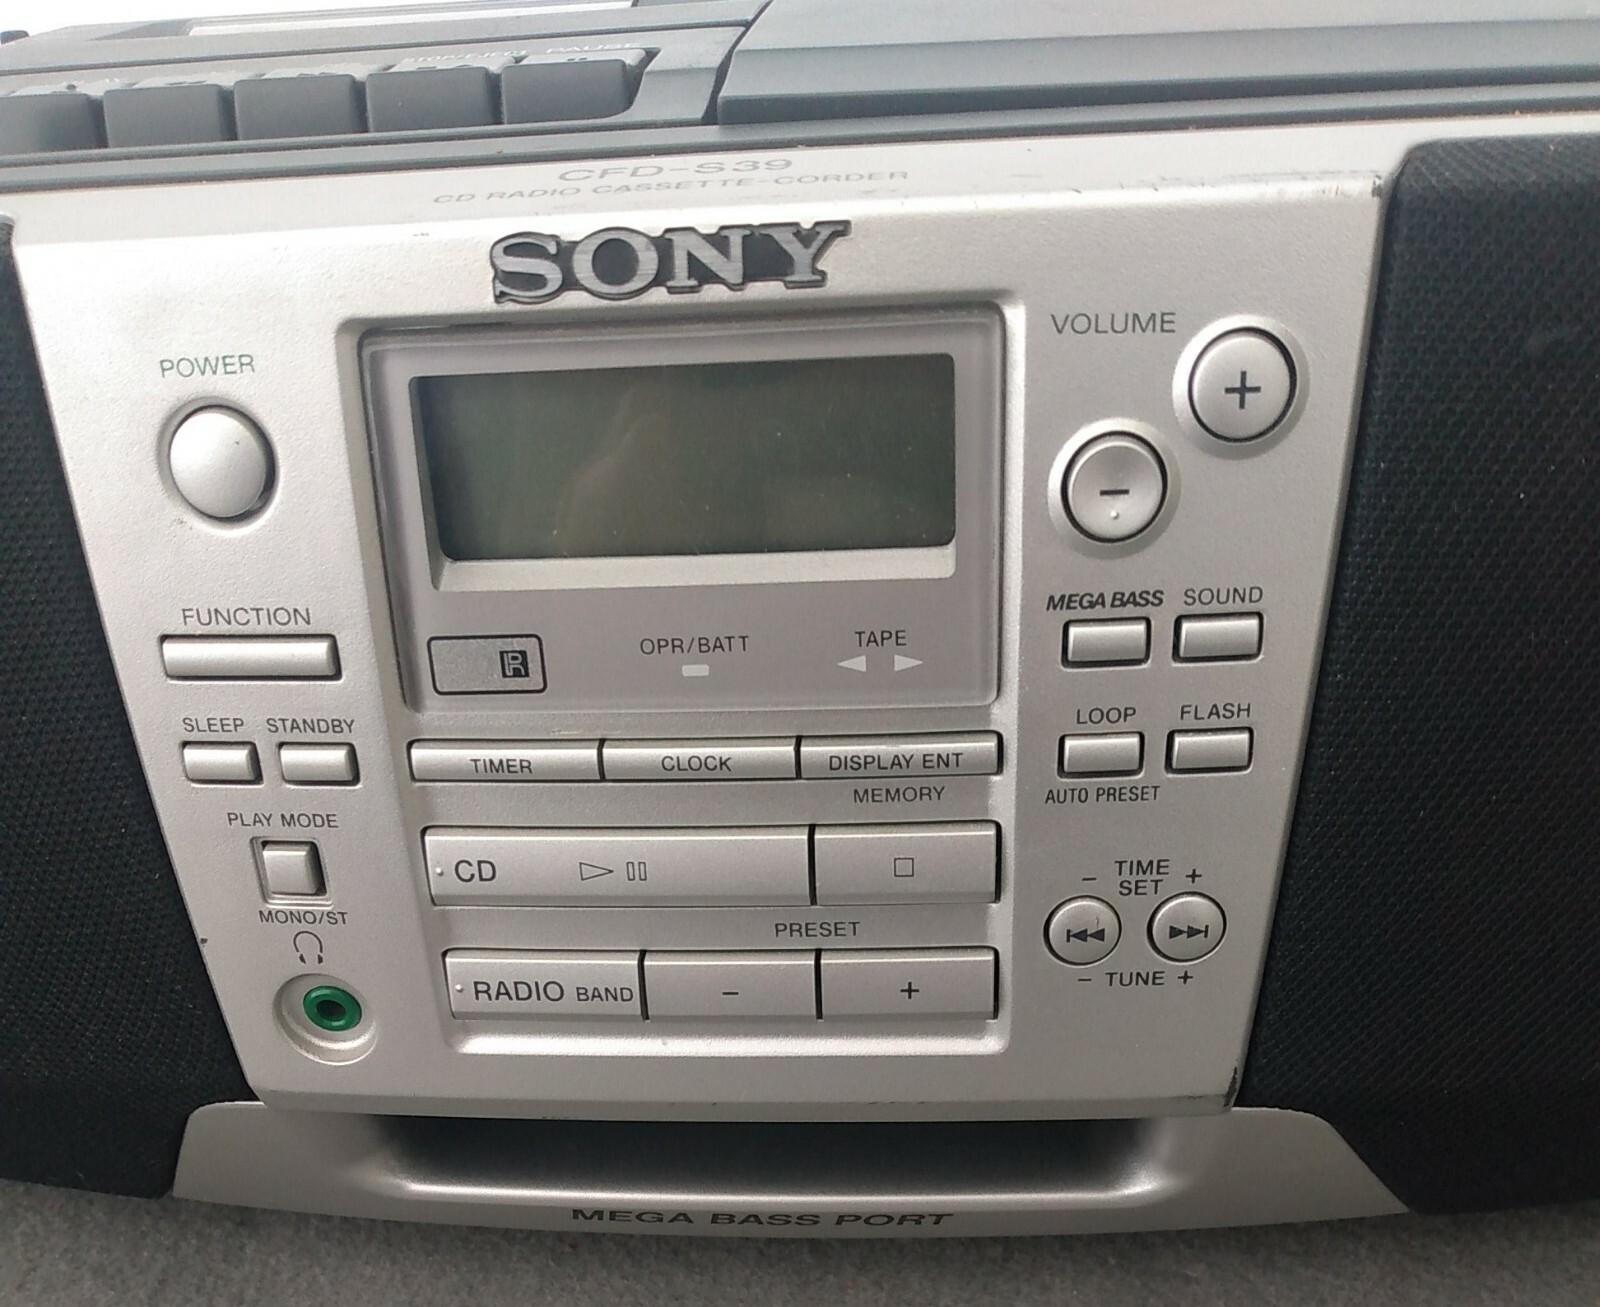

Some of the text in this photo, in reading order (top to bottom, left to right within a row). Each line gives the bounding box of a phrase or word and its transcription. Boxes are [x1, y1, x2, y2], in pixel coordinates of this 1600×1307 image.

[558, 158, 793, 182] CFD-S39
[433, 170, 909, 204] CD RADIO CASSETTE-CORDER
[491, 221, 851, 303] SONY
[1050, 311, 1177, 335] VOLUME
[159, 353, 256, 379] POWER
[1045, 589, 1165, 612] MEGA BASS
[1183, 586, 1264, 607] SOUND
[181, 606, 312, 628] FUNCTION
[639, 635, 750, 656] OPR/BATT
[854, 629, 907, 648] TAPE
[1076, 706, 1137, 725] LOOP
[1180, 702, 1251, 721] FLASH
[182, 717, 245, 733] SLEEP
[266, 717, 355, 734] STANDBY
[470, 758, 534, 775] TIMER
[661, 756, 733, 774] CLOCK
[828, 752, 964, 772] DISPLAY ENT
[853, 785, 946, 804] MEMORY
[1044, 785, 1161, 804] AUTO PRESET
[226, 812, 340, 829] PLAY MODE
[454, 859, 498, 883] CD
[1114, 859, 1170, 876] TIME
[1118, 879, 1164, 896] SET
[258, 910, 349, 926] MONO/ST
[774, 921, 861, 938] PRESET
[1105, 970, 1165, 987] TUNE
[473, 980, 634, 1003] RADIO BAND
[571, 1208, 955, 1227] MEGA BASS PORT
